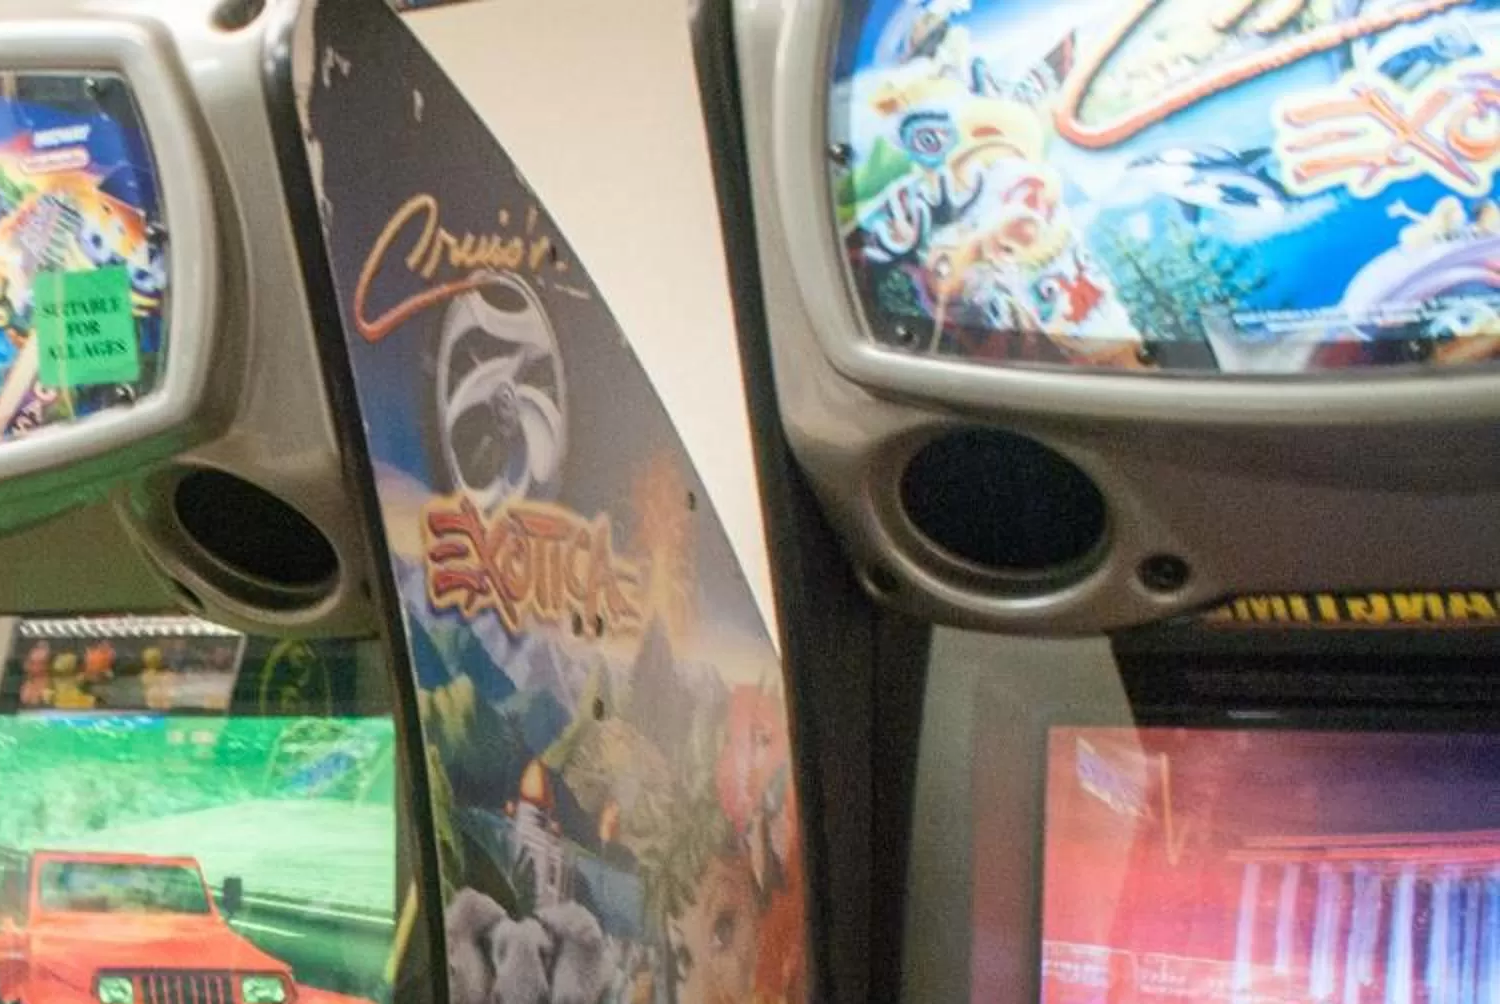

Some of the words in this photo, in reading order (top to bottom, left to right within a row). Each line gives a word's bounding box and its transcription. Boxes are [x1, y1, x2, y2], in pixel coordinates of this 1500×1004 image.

[66, 319, 101, 338] FOR
[83, 337, 129, 358] AGES
[421, 494, 642, 638] EXOTICA
